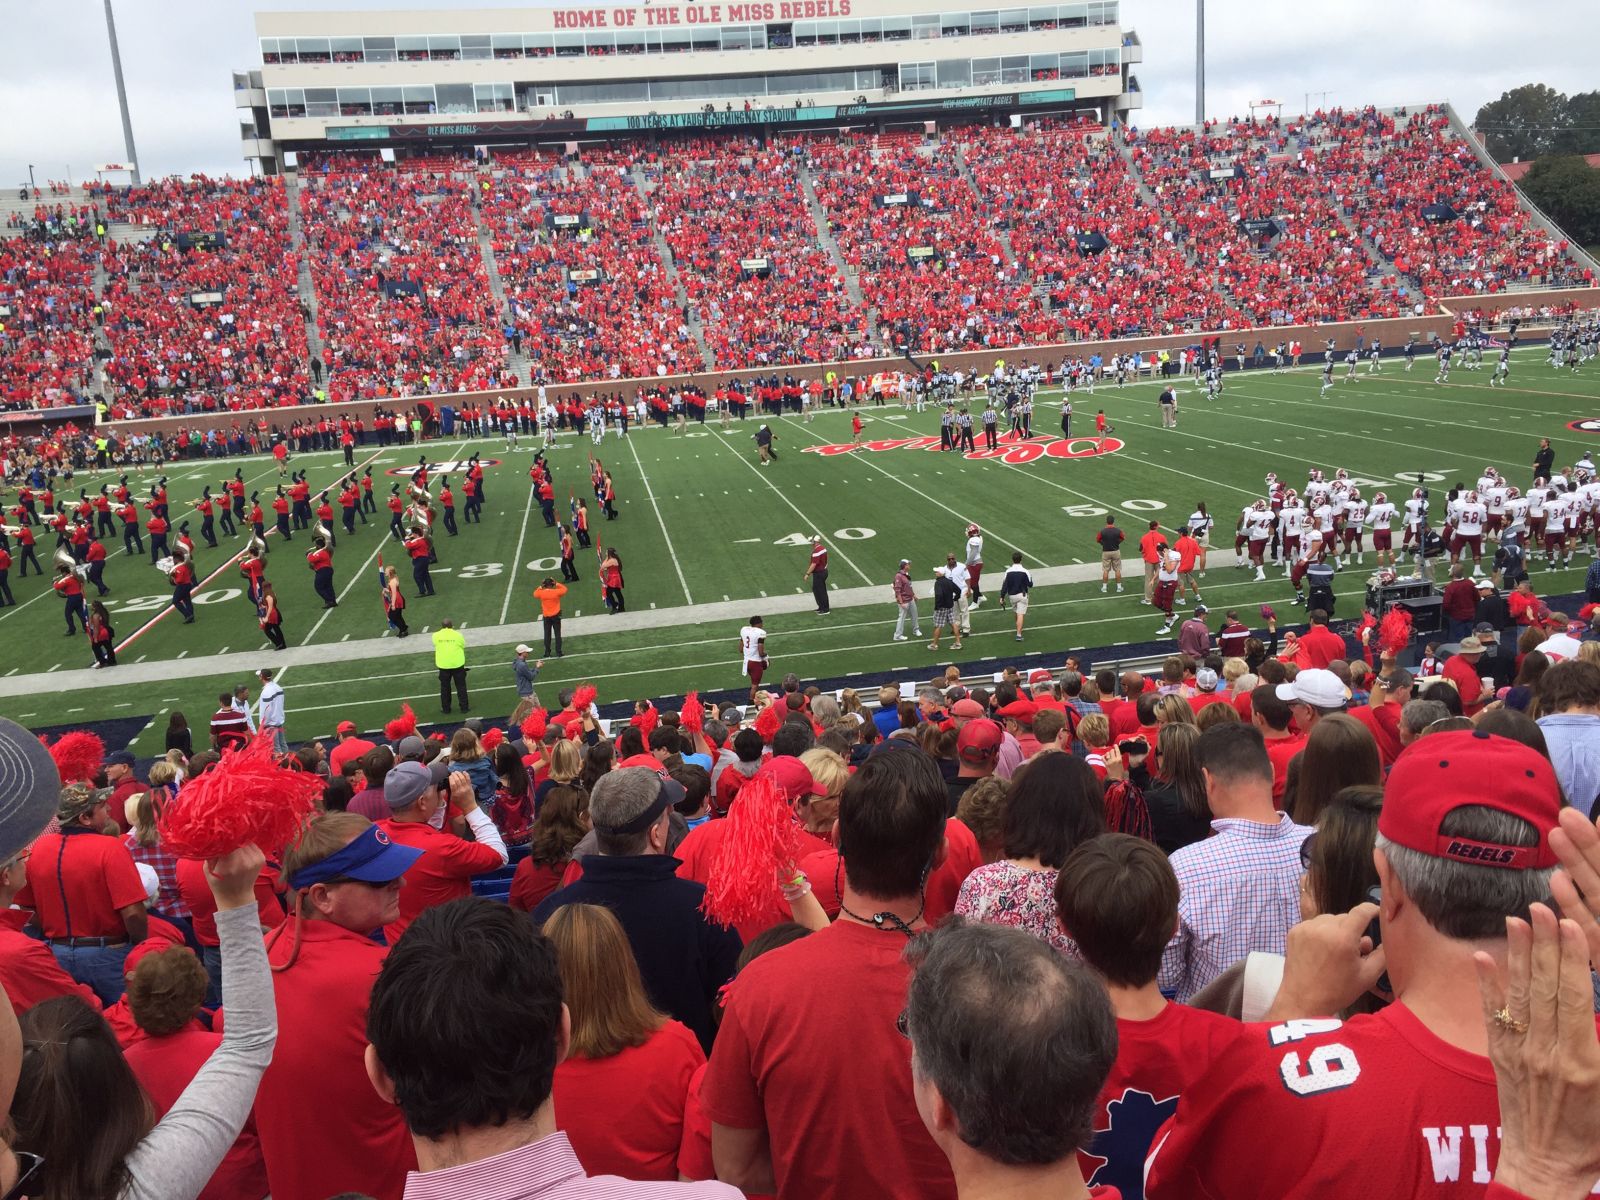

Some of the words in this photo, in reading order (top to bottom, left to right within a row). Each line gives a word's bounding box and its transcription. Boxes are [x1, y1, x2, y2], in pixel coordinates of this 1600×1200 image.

[552, 9, 608, 29] HOME
[613, 8, 637, 27] OF
[644, 6, 681, 25] THE
[685, 5, 722, 24] OLE
[727, 3, 775, 22] MISS
[780, 0, 852, 19] REBELS
[626, 115, 641, 129] 100
[642, 114, 668, 129] YEARS
[669, 113, 680, 127] AT
[763, 108, 798, 123] STADIUM
[1061, 499, 1168, 517] 50
[1493, 495, 1502, 507] 9
[1289, 514, 1296, 528] 4
[1353, 507, 1365, 520] 29
[1462, 511, 1479, 524] 58
[745, 635, 751, 649] 3
[1447, 841, 1517, 863] REBELS
[1267, 1018, 1362, 1098] 49
[1421, 1124, 1502, 1184] WI
